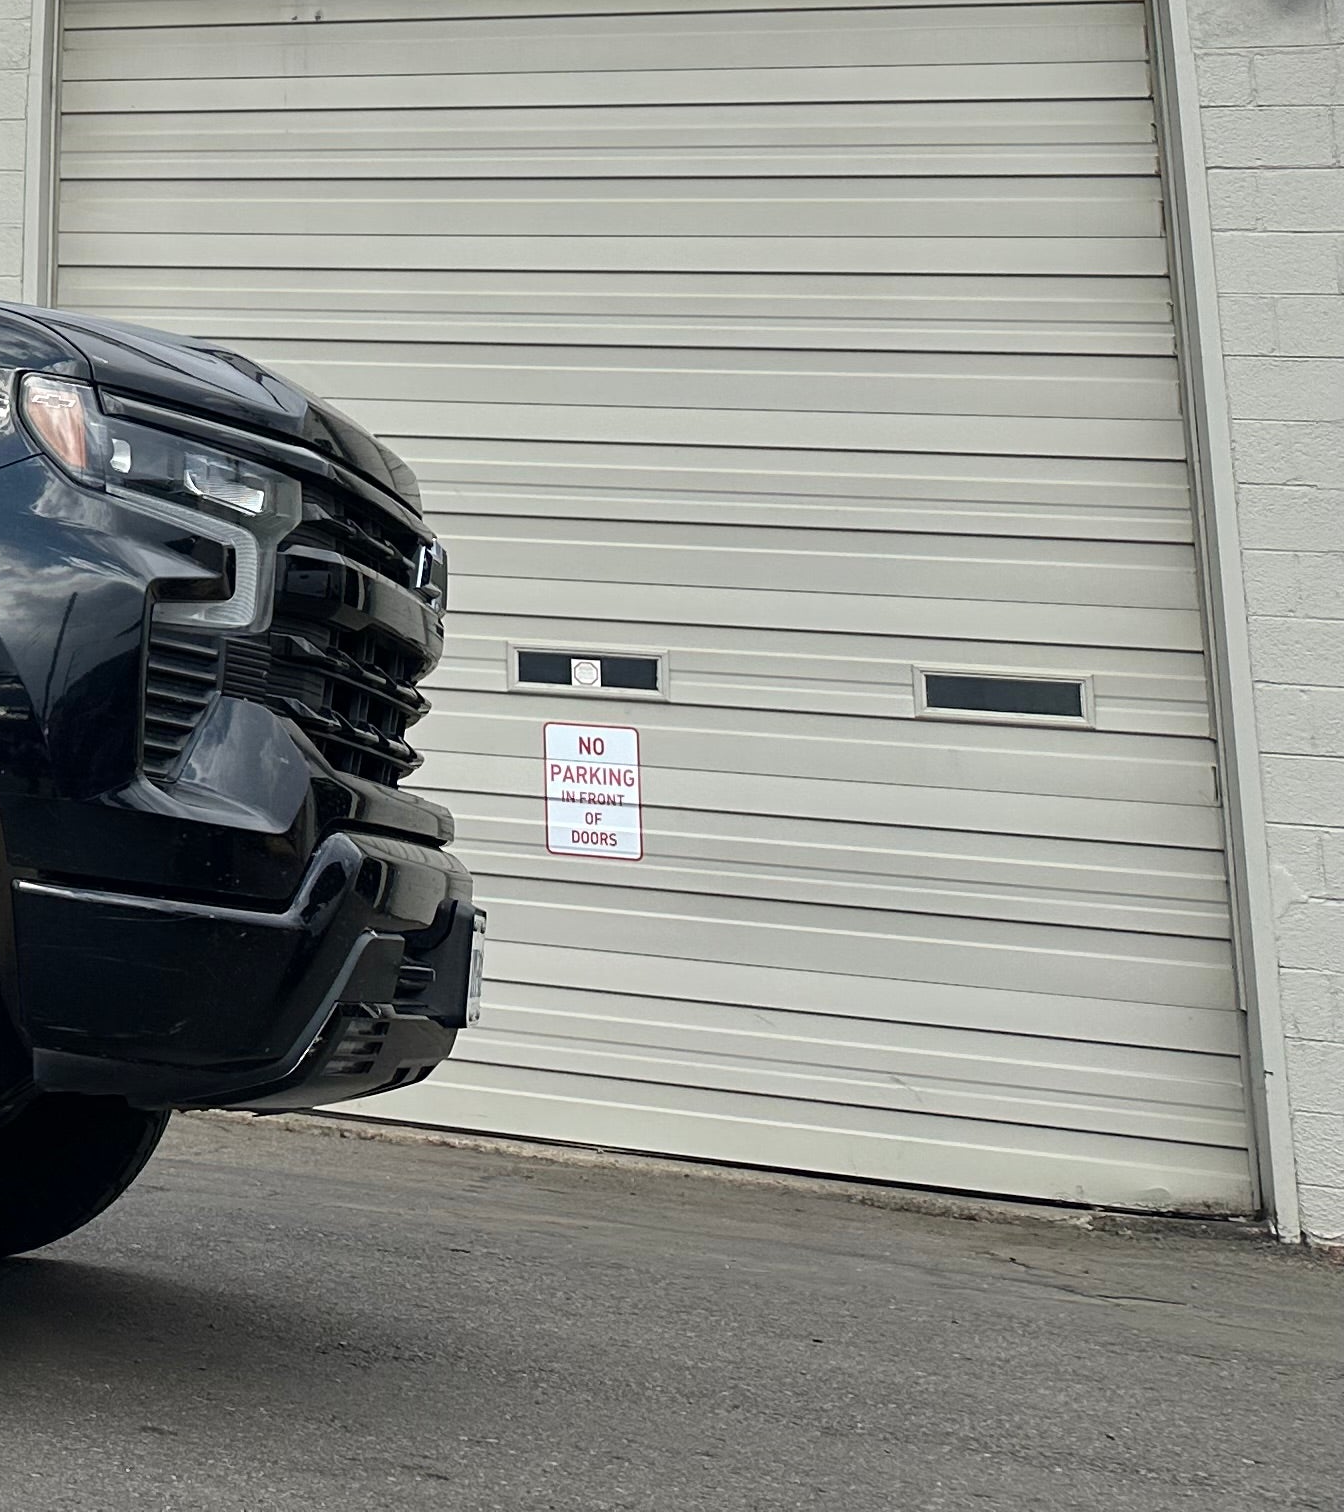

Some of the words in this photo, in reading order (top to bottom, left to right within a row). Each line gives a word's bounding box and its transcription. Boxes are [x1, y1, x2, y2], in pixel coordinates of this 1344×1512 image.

[578, 736, 605, 756] NO
[550, 763, 635, 788] PARKING
[561, 790, 575, 803] IN
[579, 791, 625, 807] FRONT
[585, 811, 602, 826] OF
[571, 829, 618, 847] DOORS
